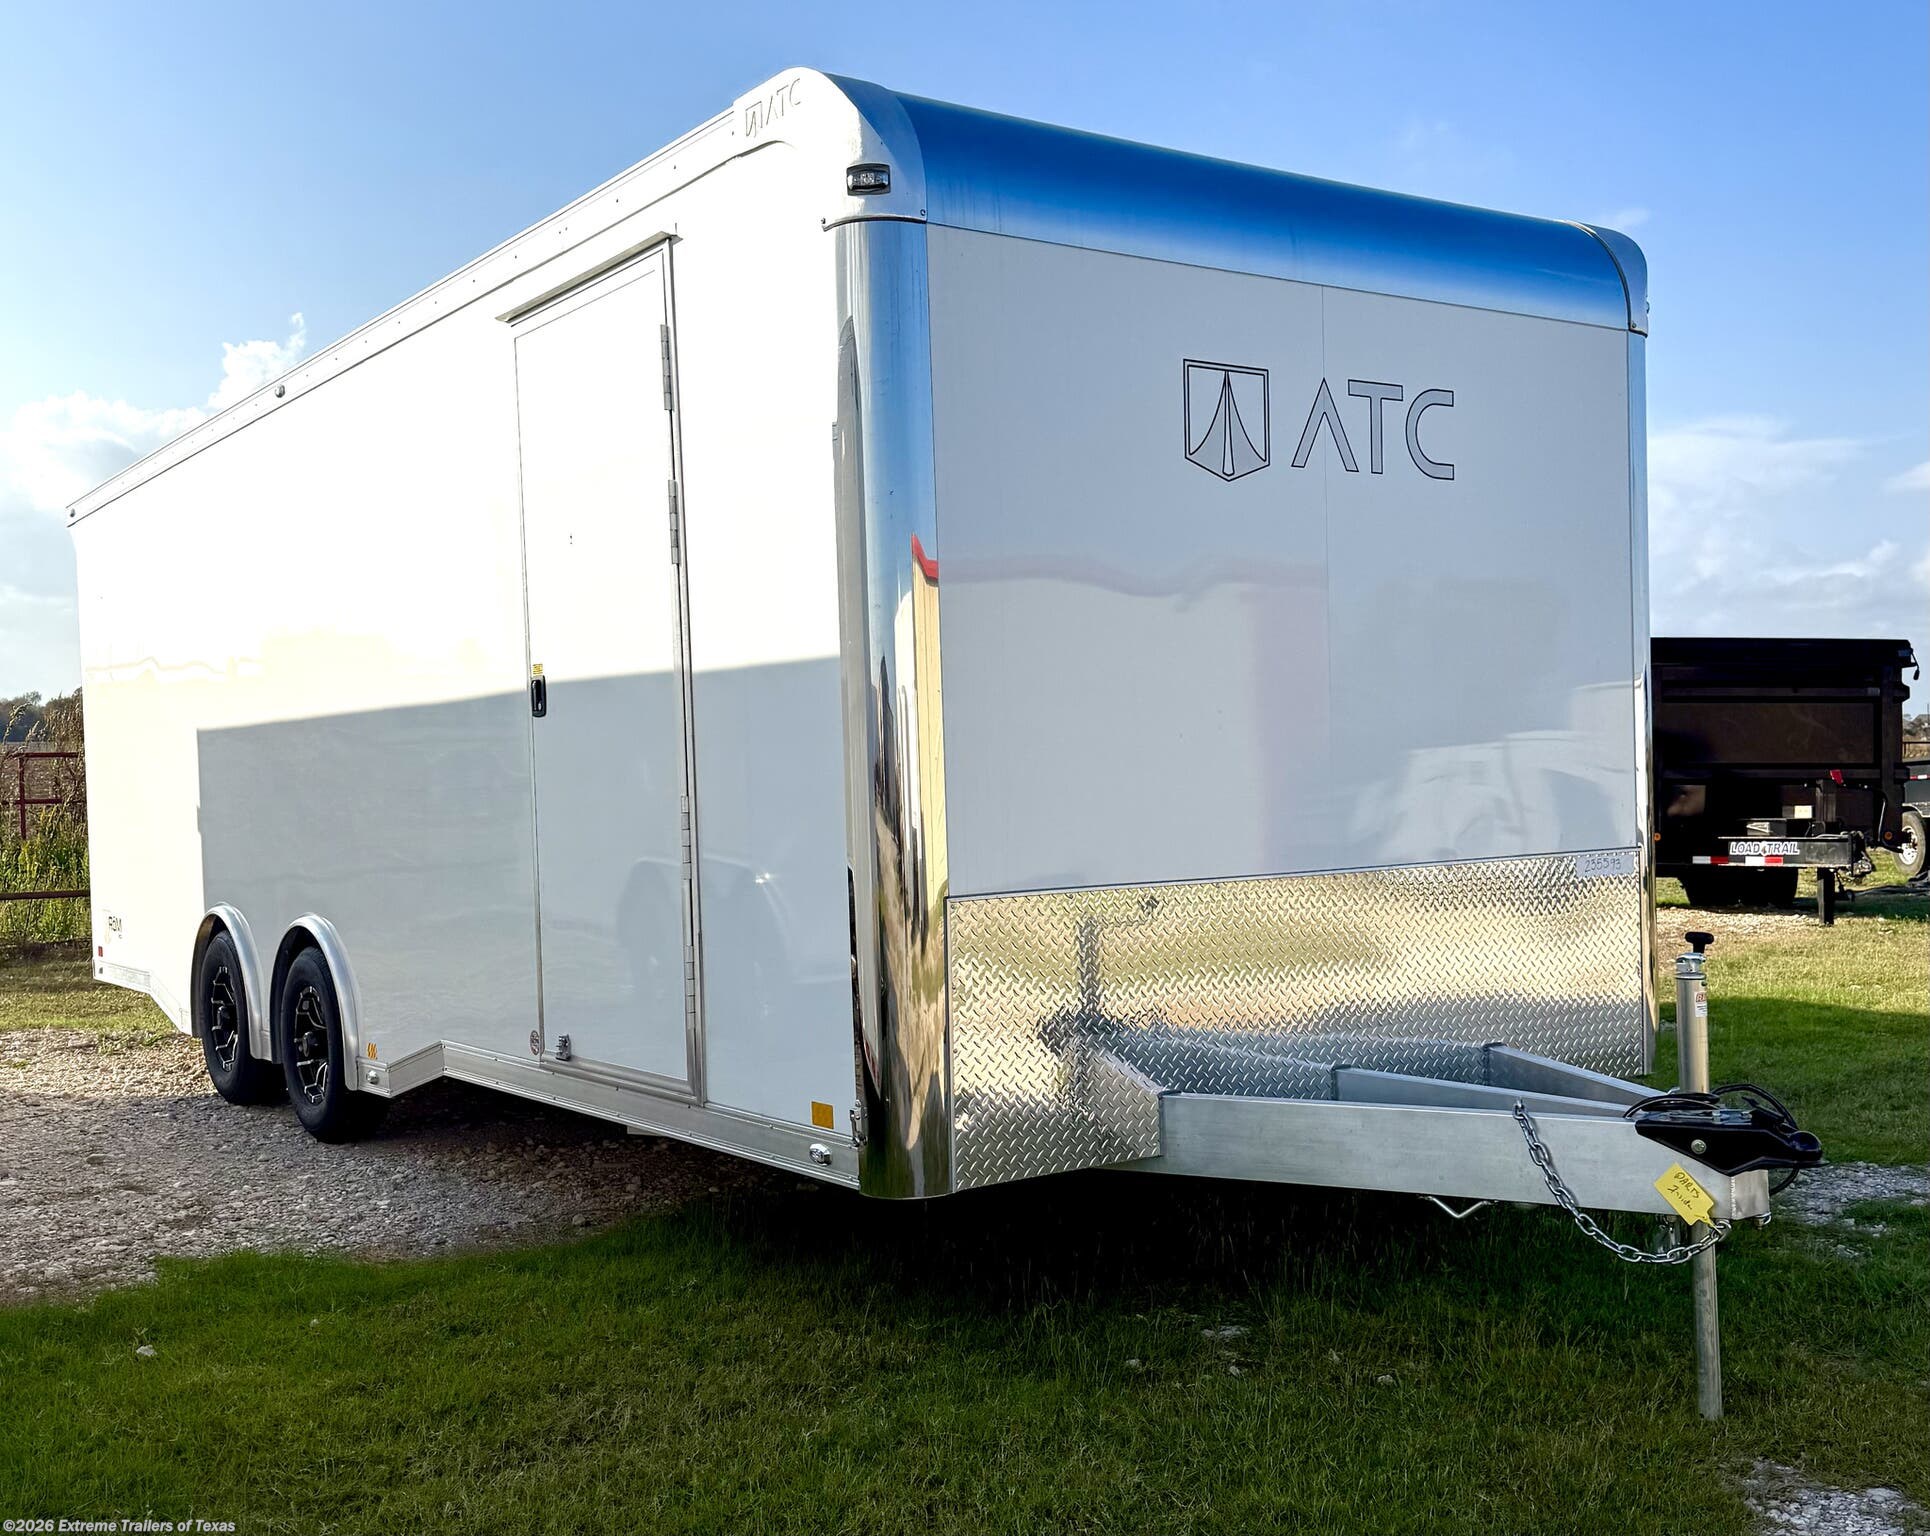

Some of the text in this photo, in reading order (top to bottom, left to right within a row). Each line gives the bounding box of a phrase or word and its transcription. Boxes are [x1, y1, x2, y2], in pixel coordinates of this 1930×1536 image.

[1290, 377, 1455, 480] ATC
[1730, 842, 1800, 855] LOAD TRAIL
